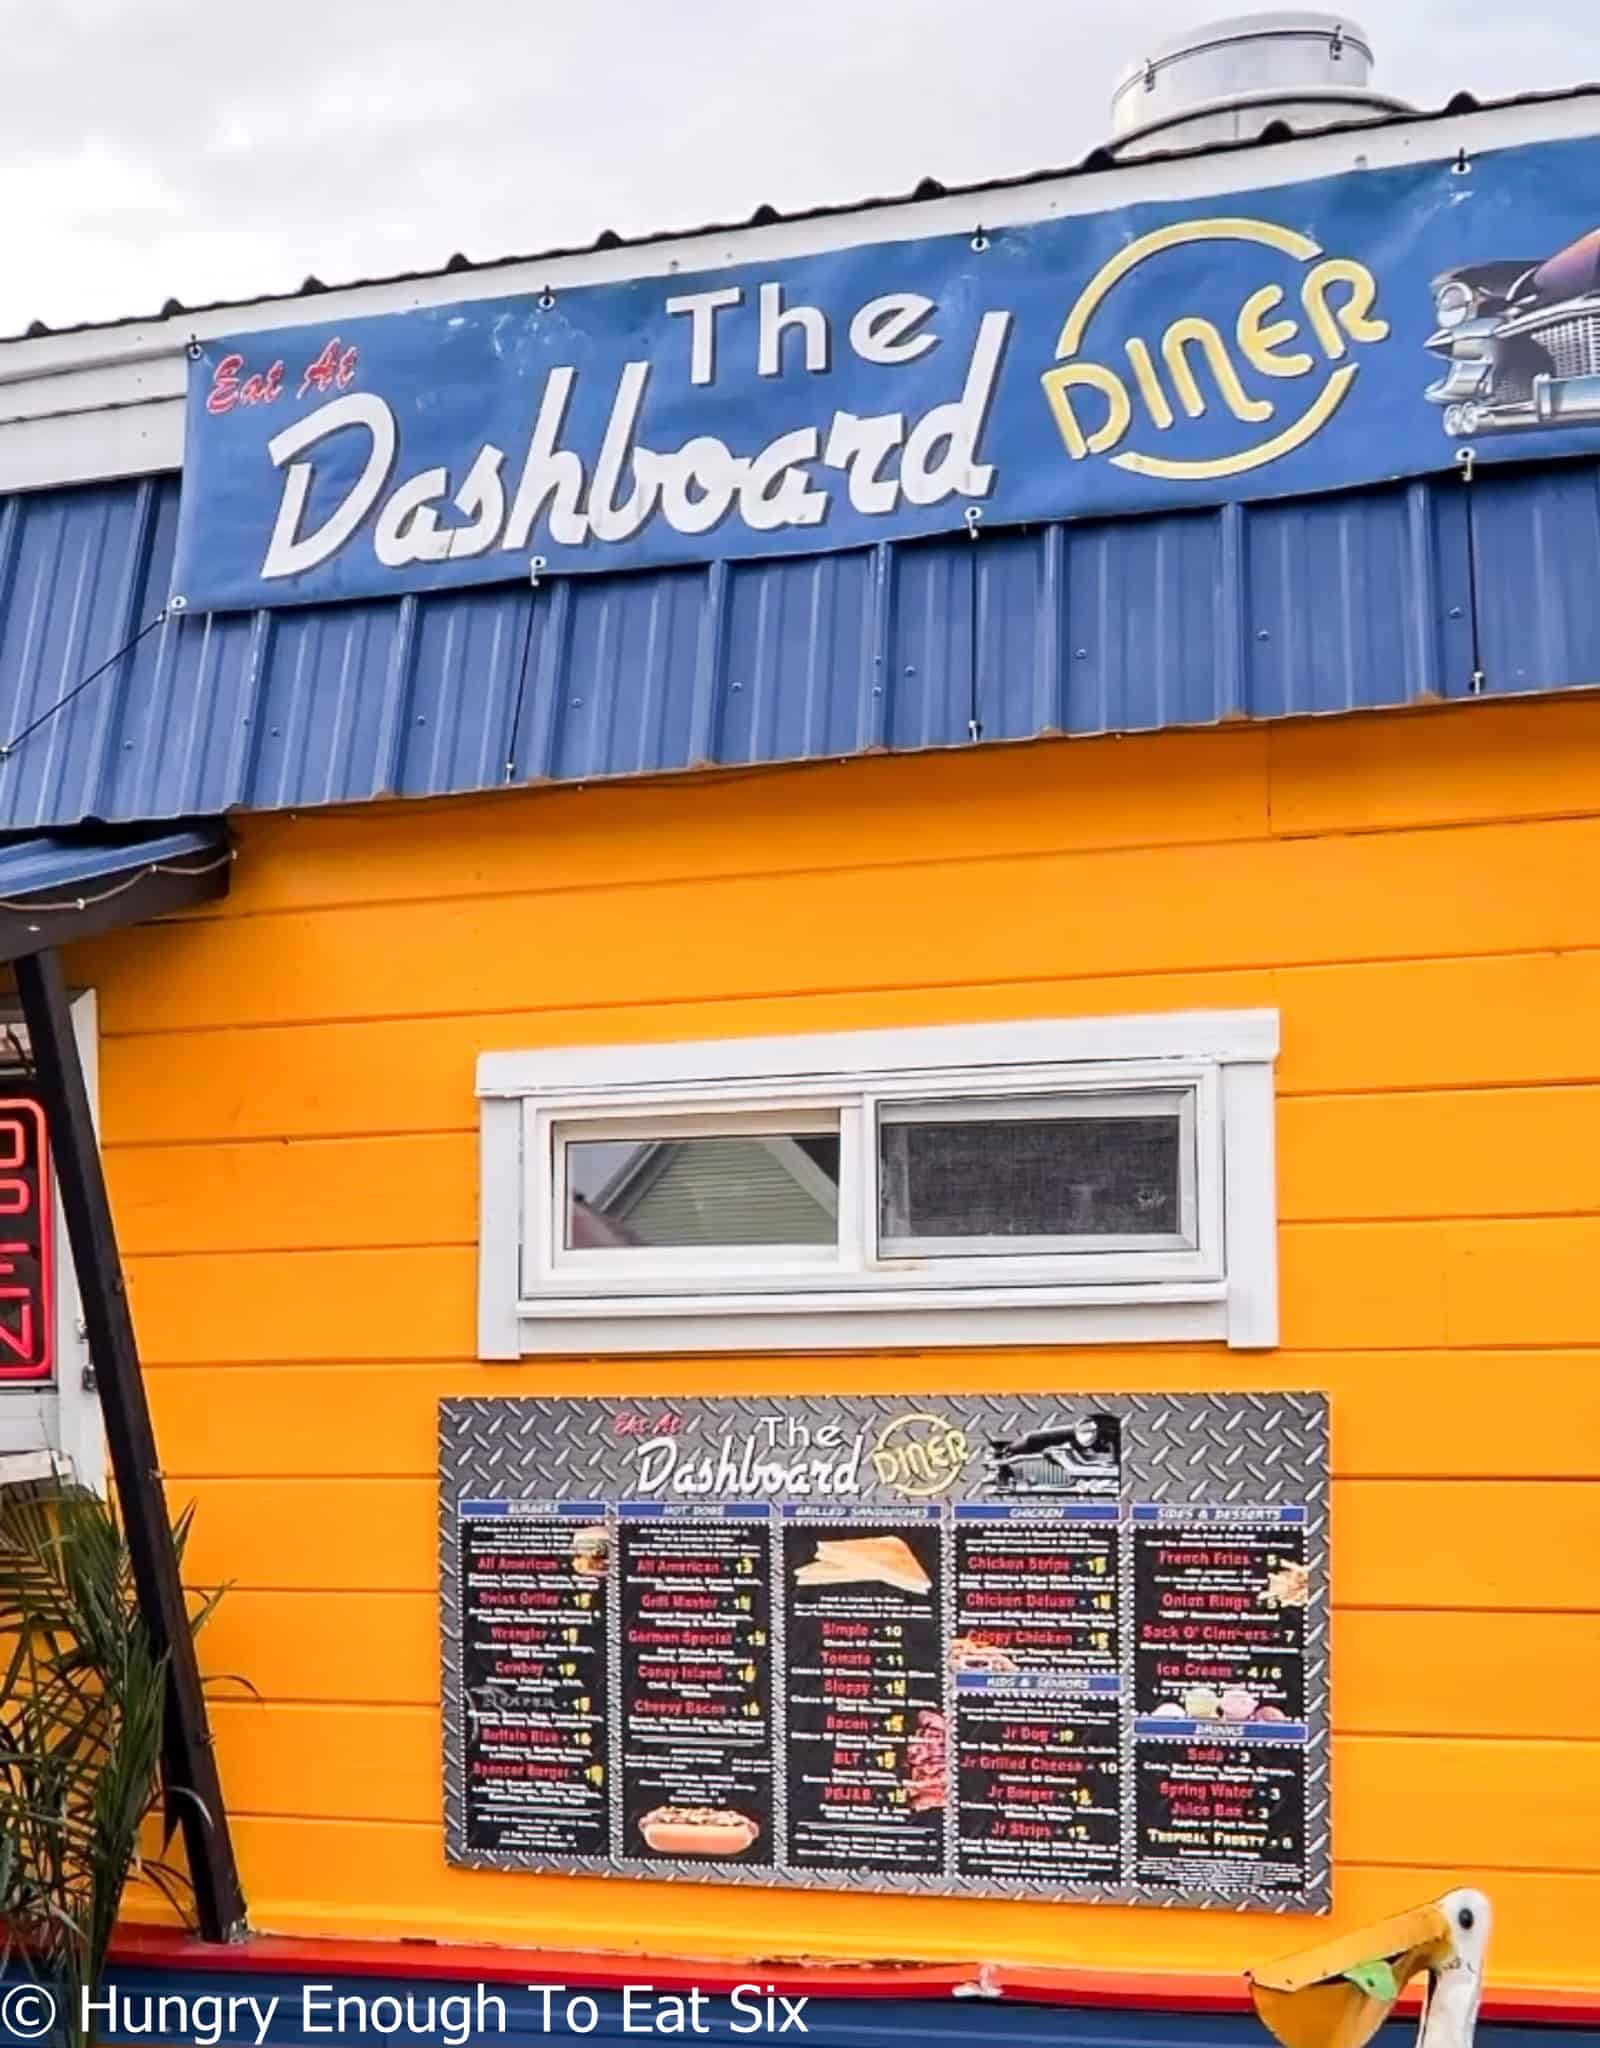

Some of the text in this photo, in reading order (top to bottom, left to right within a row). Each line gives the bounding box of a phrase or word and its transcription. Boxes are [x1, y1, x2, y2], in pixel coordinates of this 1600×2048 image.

[665, 282, 938, 384] The
[1041, 259, 1389, 459] DINER
[207, 336, 357, 415] Eat At
[261, 311, 1010, 578] Dashboard
[614, 1411, 684, 1436] Eat At
[759, 1416, 842, 1447] The
[637, 1435, 863, 1494] Dashboard
[873, 1430, 970, 1484] DINER
[1009, 1508, 1064, 1518] CHICKEN
[1158, 1508, 1193, 1519] SIDES
[1215, 1508, 1281, 1521] DESSERTS
[498, 1558, 559, 1570] American
[638, 1559, 654, 1573] All
[658, 1560, 720, 1574] American
[968, 1556, 1024, 1571] Chicken
[1028, 1557, 1070, 1573] Strips
[1159, 1551, 1209, 1565] French
[1213, 1552, 1250, 1566] Fries
[673, 1595, 718, 1609] Master
[966, 1593, 1022, 1608] Chicken
[1026, 1594, 1076, 1609] Deluxe
[1162, 1593, 1205, 1607] Onion
[1209, 1595, 1251, 1611] Rings
[491, 1626, 548, 1642] Wrangler
[629, 1630, 680, 1644] German
[683, 1631, 732, 1647] Special
[822, 1623, 902, 1638] Simple 10
[967, 1630, 1011, 1646] Crispy
[1015, 1631, 1073, 1645] Chicken
[1143, 1625, 1179, 1639] Sack
[1285, 1630, 1296, 1643] 7
[822, 1651, 904, 1666] Tomato 11
[495, 1661, 545, 1677] Cowboy
[638, 1664, 678, 1680] Coney
[682, 1666, 722, 1680] Island
[1157, 1663, 1179, 1676] Ice
[1184, 1664, 1233, 1678] Cream
[824, 1680, 870, 1696] Sloppy
[686, 1702, 726, 1715] Bacon
[827, 1715, 869, 1730] Bacon
[1002, 1727, 1017, 1740] Jr
[1020, 1727, 1049, 1742] Dog
[834, 1752, 861, 1765] BLT
[1187, 1748, 1251, 1763] Soda 3
[960, 1756, 1118, 1774] Jr Grilled Cheese 10
[988, 1786, 1003, 1799] Jr
[1006, 1786, 1054, 1802] Burger
[1160, 1782, 1281, 1800] Spring Water 3
[1171, 1802, 1269, 1819] Juice Box 3
[992, 1823, 1006, 1835] Jr
[1009, 1823, 1051, 1840] Strips
